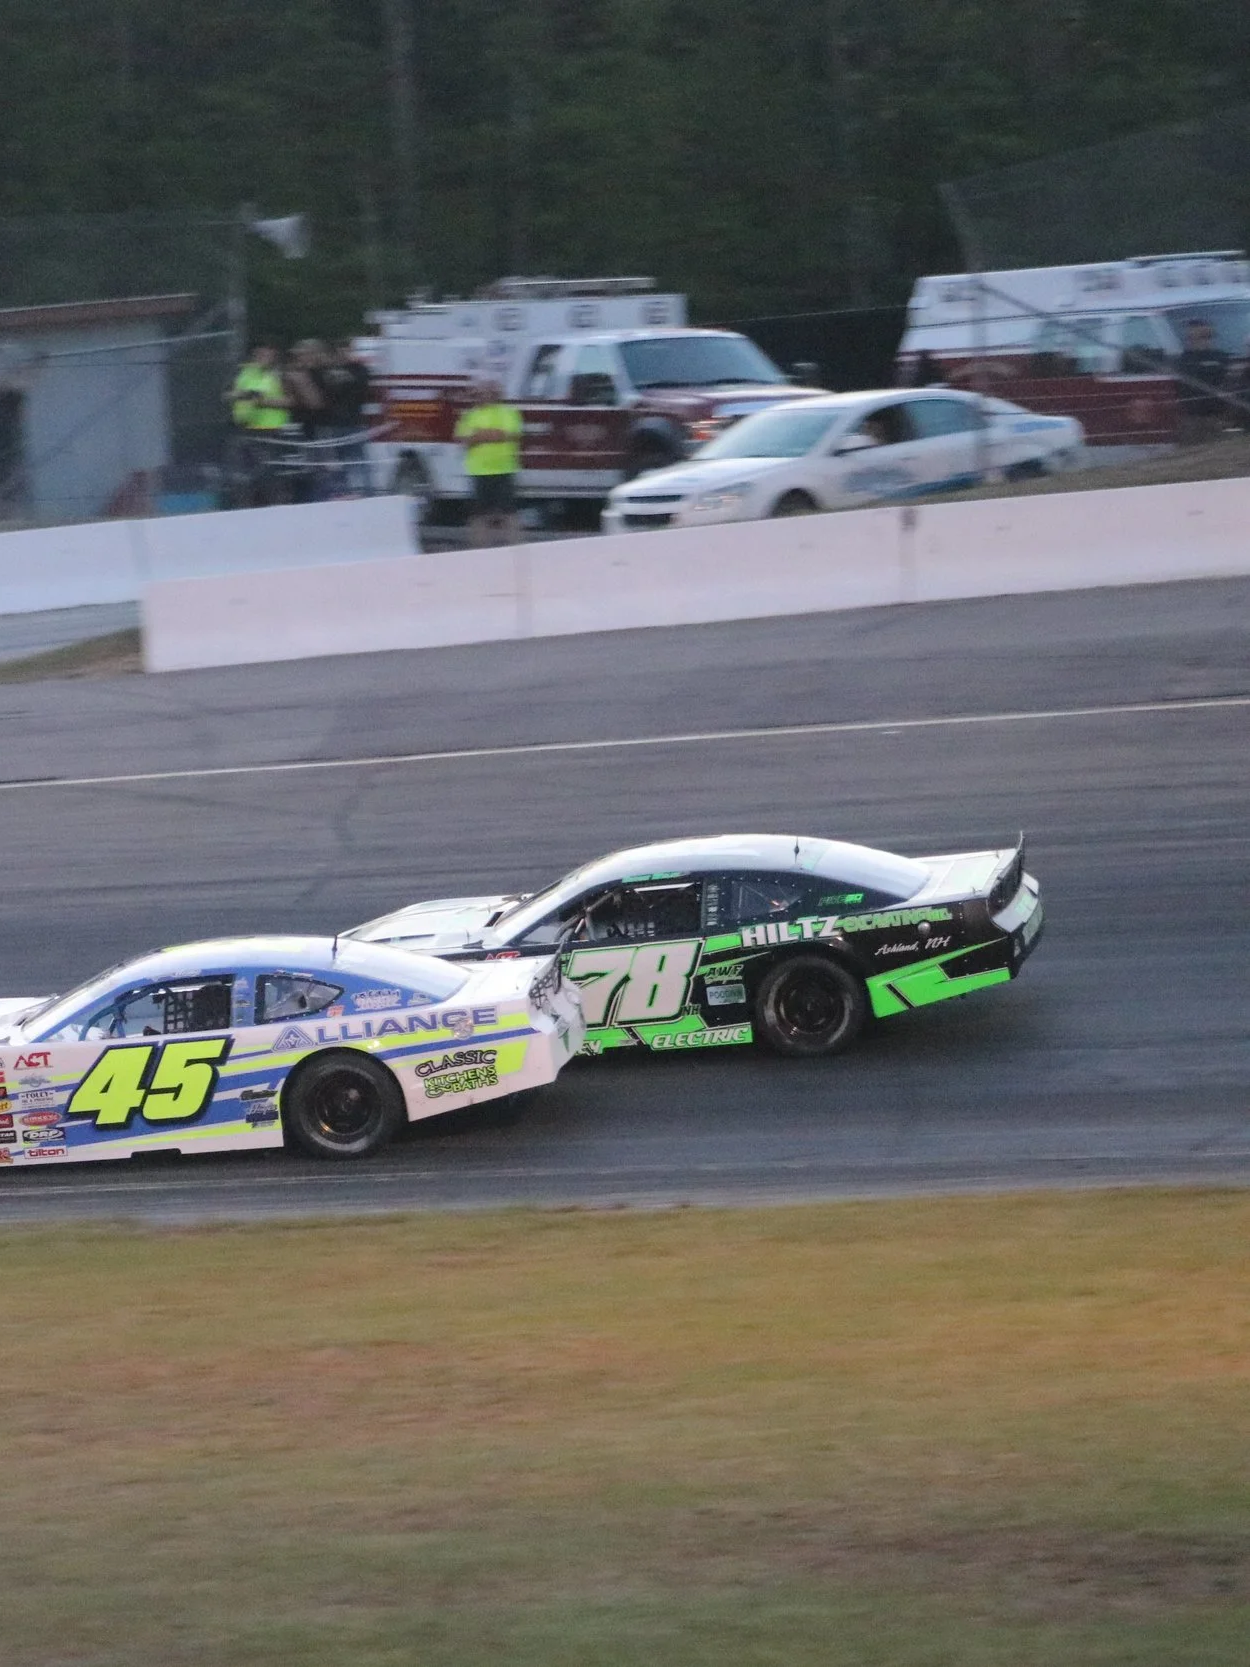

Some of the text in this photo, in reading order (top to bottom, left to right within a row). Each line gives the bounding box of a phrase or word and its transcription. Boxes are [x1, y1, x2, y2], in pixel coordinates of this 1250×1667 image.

[741, 914, 841, 948] HILTZ
[924, 936, 951, 949] NH
[566, 941, 700, 1024] 78
[651, 1027, 750, 1050] ELECTRIC
[14, 1052, 51, 1069] ACT
[415, 1050, 497, 1077] CLASSIC
[67, 1037, 227, 1125] 45
[423, 1065, 497, 1090] KITCHENS
[452, 1075, 498, 1093] BATHS
[27, 1148, 65, 1158] tilton
